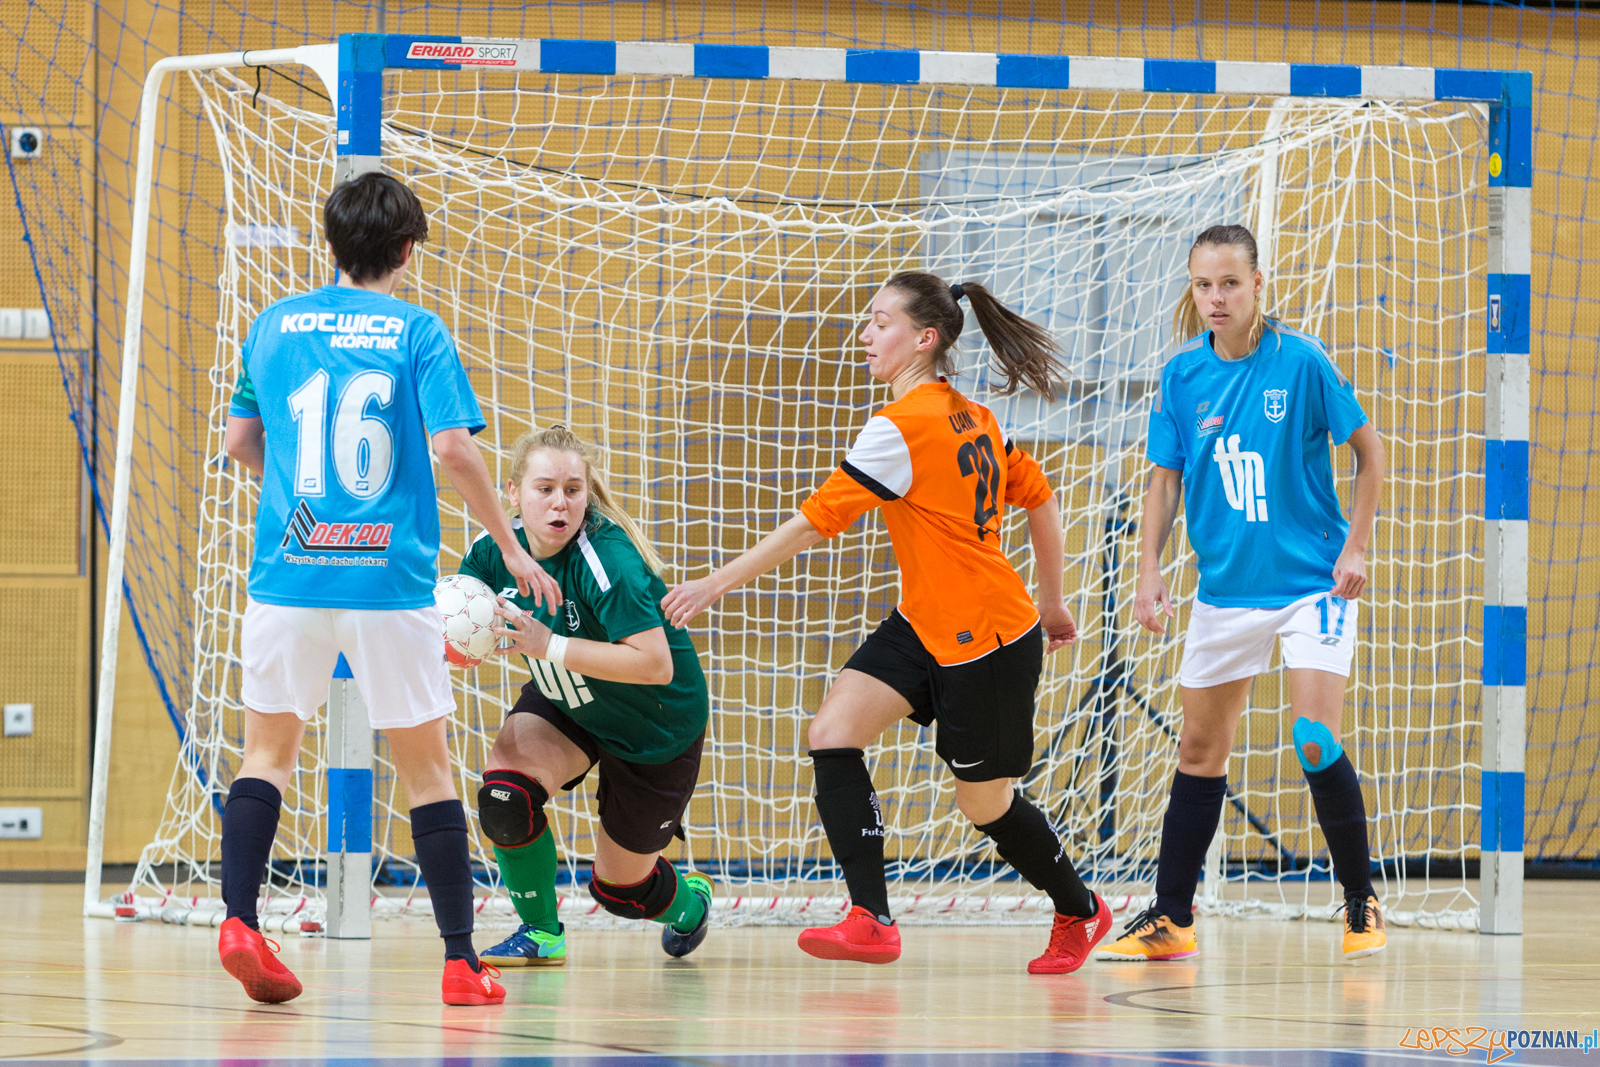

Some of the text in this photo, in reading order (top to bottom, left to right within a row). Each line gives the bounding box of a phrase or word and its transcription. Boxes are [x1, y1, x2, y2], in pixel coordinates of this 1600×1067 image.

[411, 45, 512, 59] ERHARD SPORT
[280, 312, 405, 335] KOTWICA
[330, 332, 399, 350] KÓRNIK
[287, 367, 396, 500] 16
[948, 409, 978, 435] UAM
[957, 433, 1000, 542] 20
[284, 553, 316, 565] Wszystko
[317, 555, 329, 566] dla
[331, 556, 353, 566] dachu
[360, 557, 388, 567] dekarzy
[1314, 595, 1348, 637] 17
